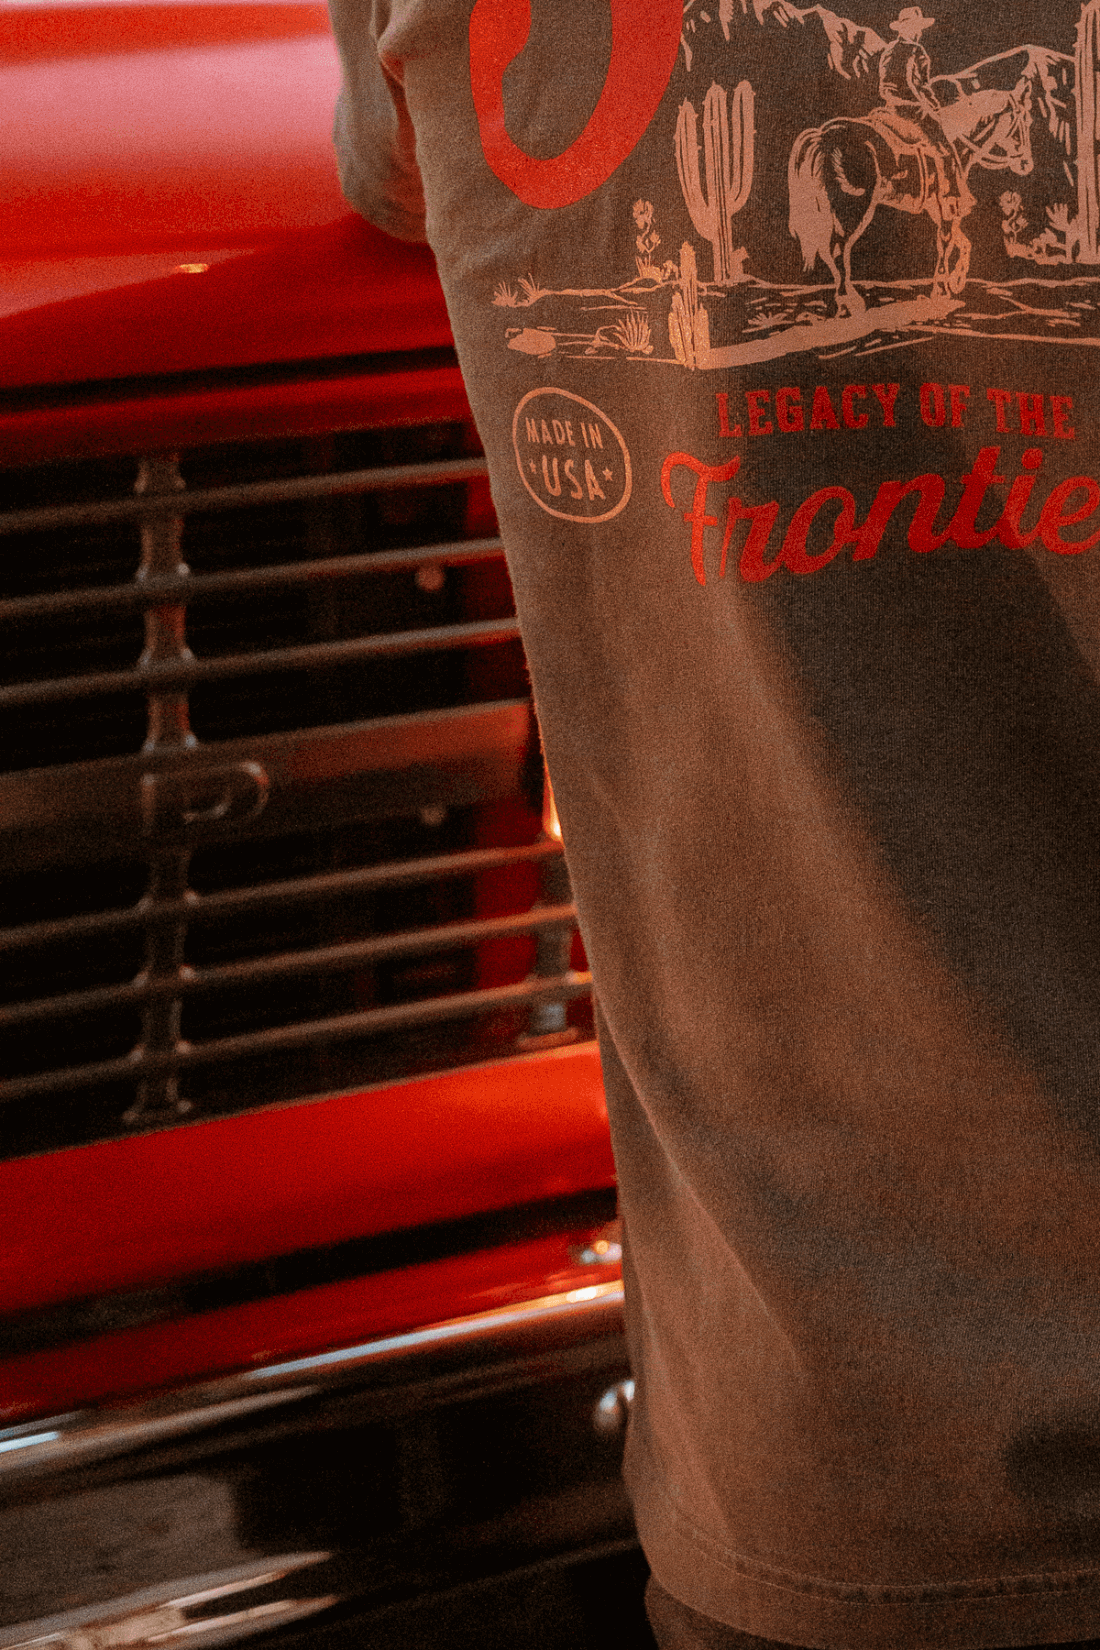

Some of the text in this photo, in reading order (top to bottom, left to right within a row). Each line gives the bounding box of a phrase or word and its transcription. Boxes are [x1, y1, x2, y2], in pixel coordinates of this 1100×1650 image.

[525, 417, 604, 449] MADE IN
[715, 383, 1076, 439] LEGACY OF THE
[541, 455, 606, 500] USA
